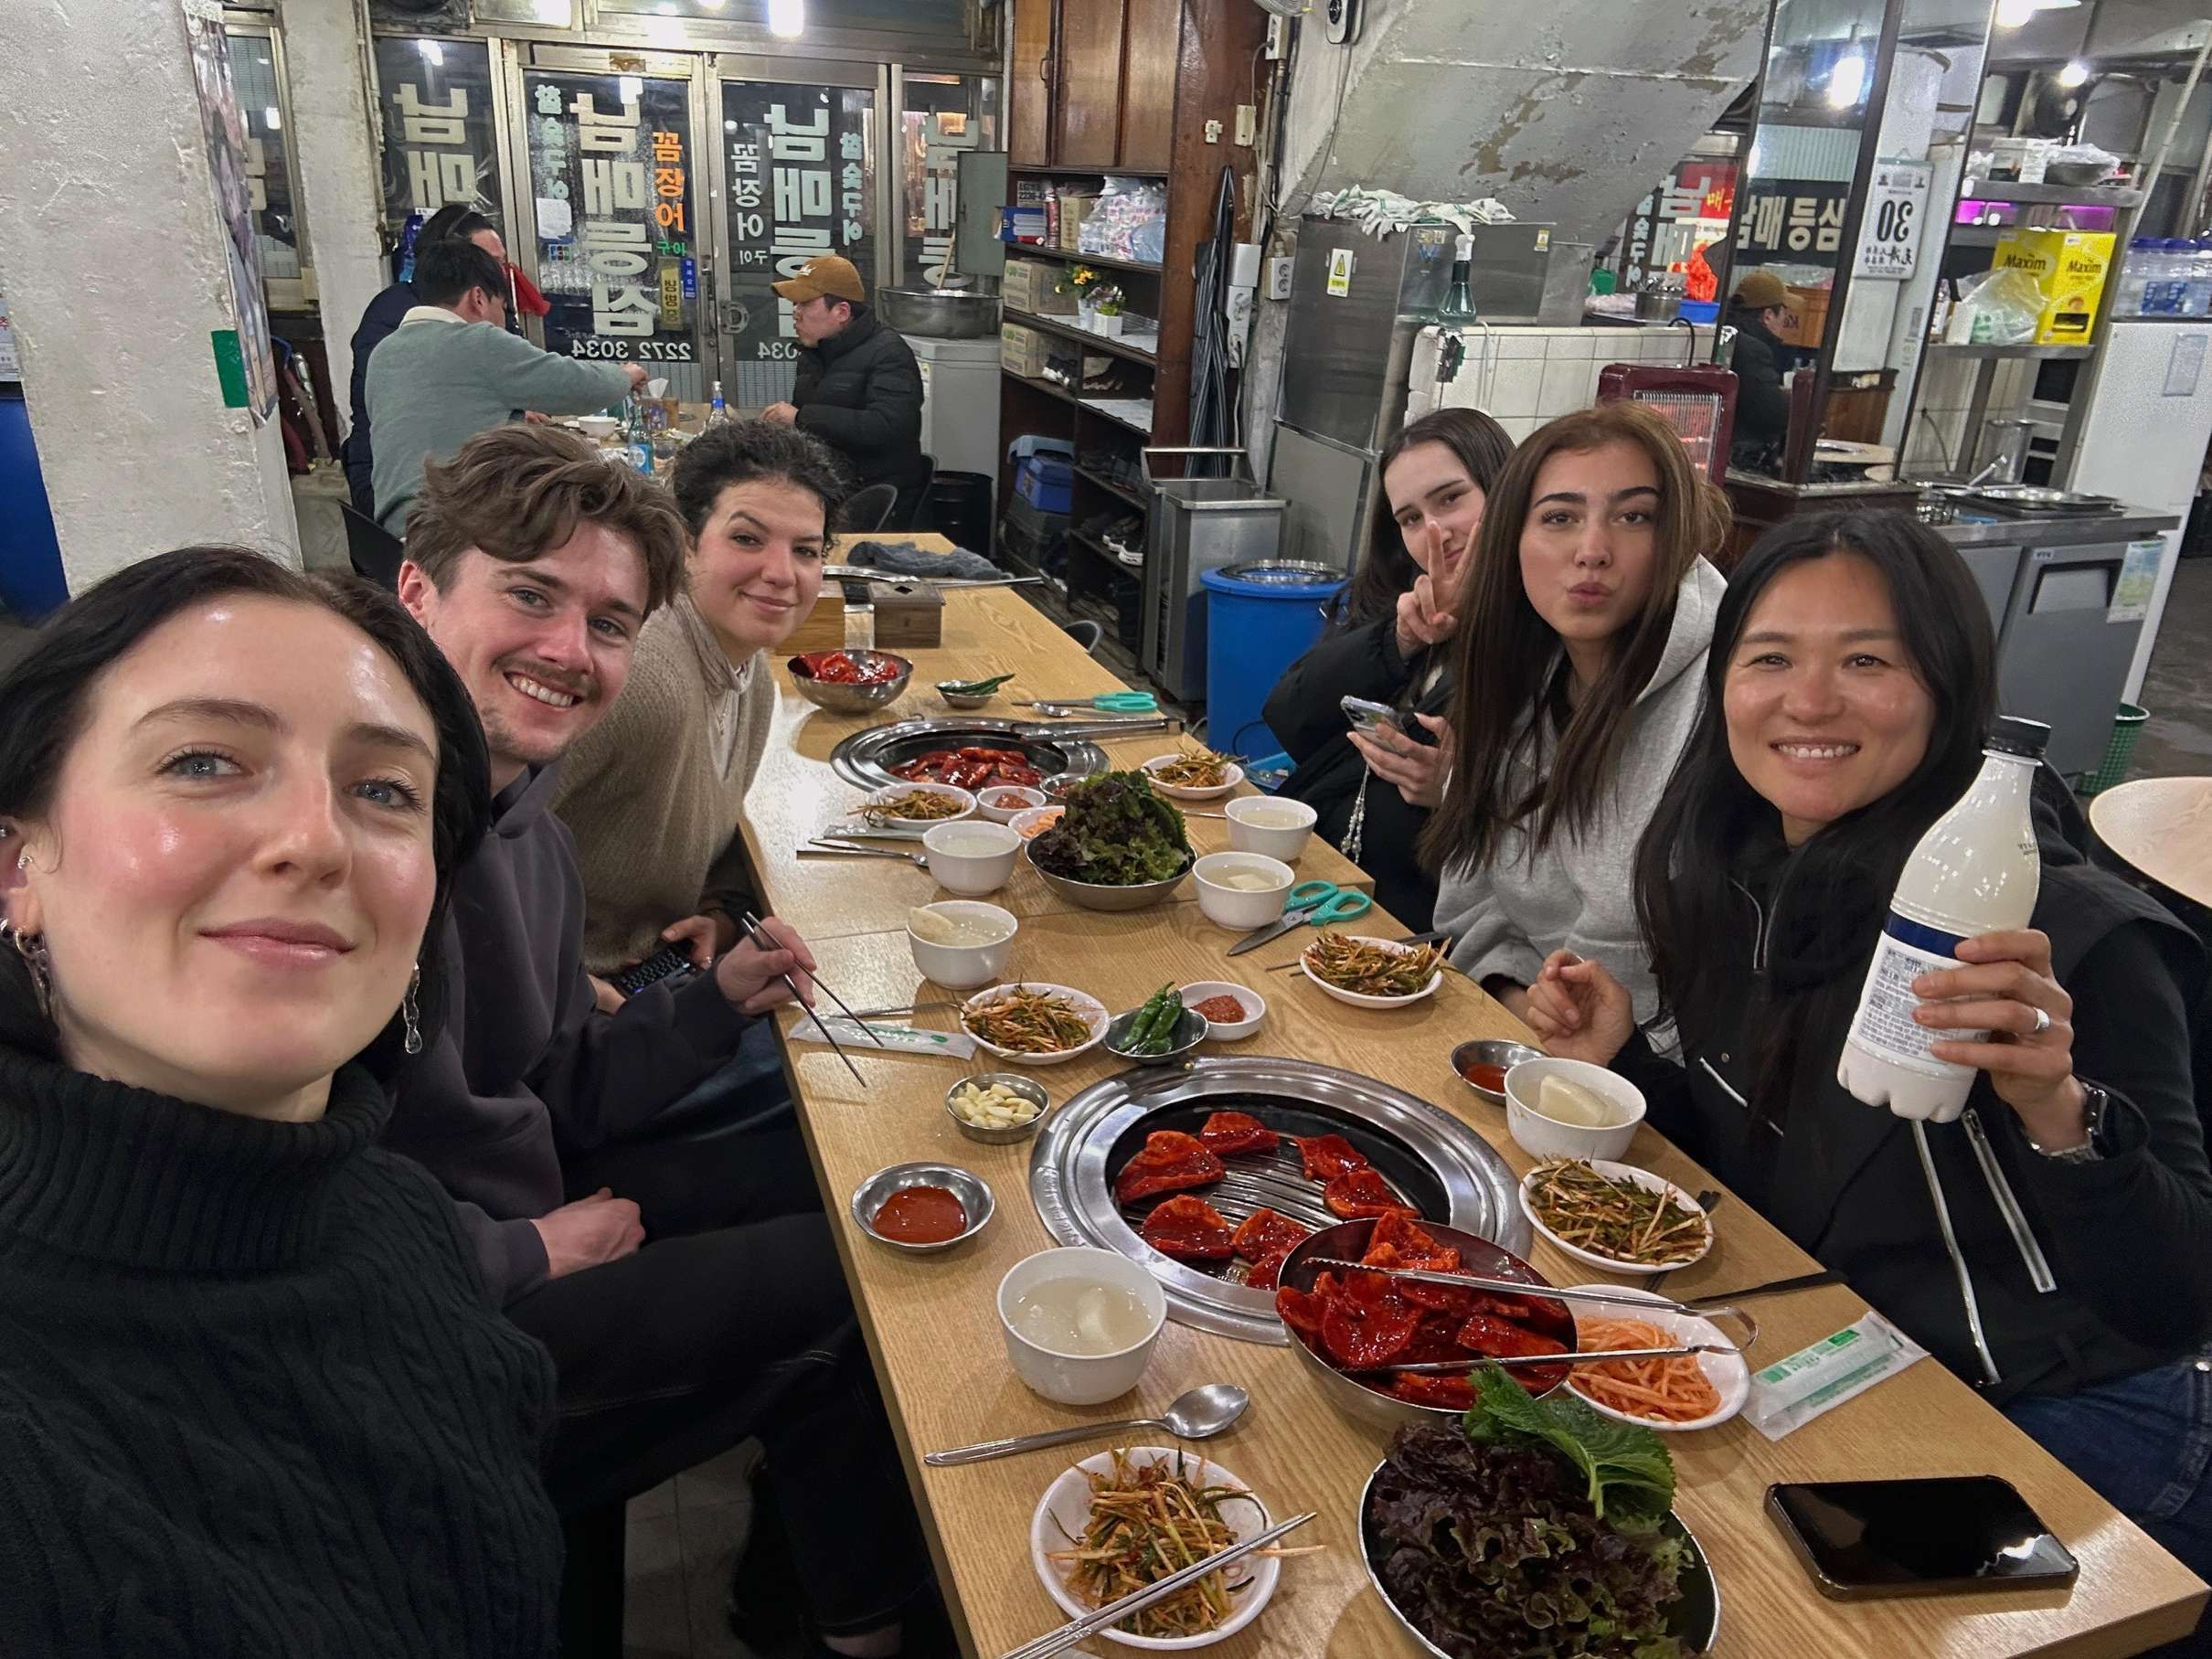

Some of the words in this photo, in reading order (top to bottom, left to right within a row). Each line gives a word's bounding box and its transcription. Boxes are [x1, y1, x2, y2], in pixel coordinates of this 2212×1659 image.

[652, 132, 686, 233] 꼼장어
[2004, 253, 2047, 271] Maxim
[2066, 260, 2102, 274] Maxim
